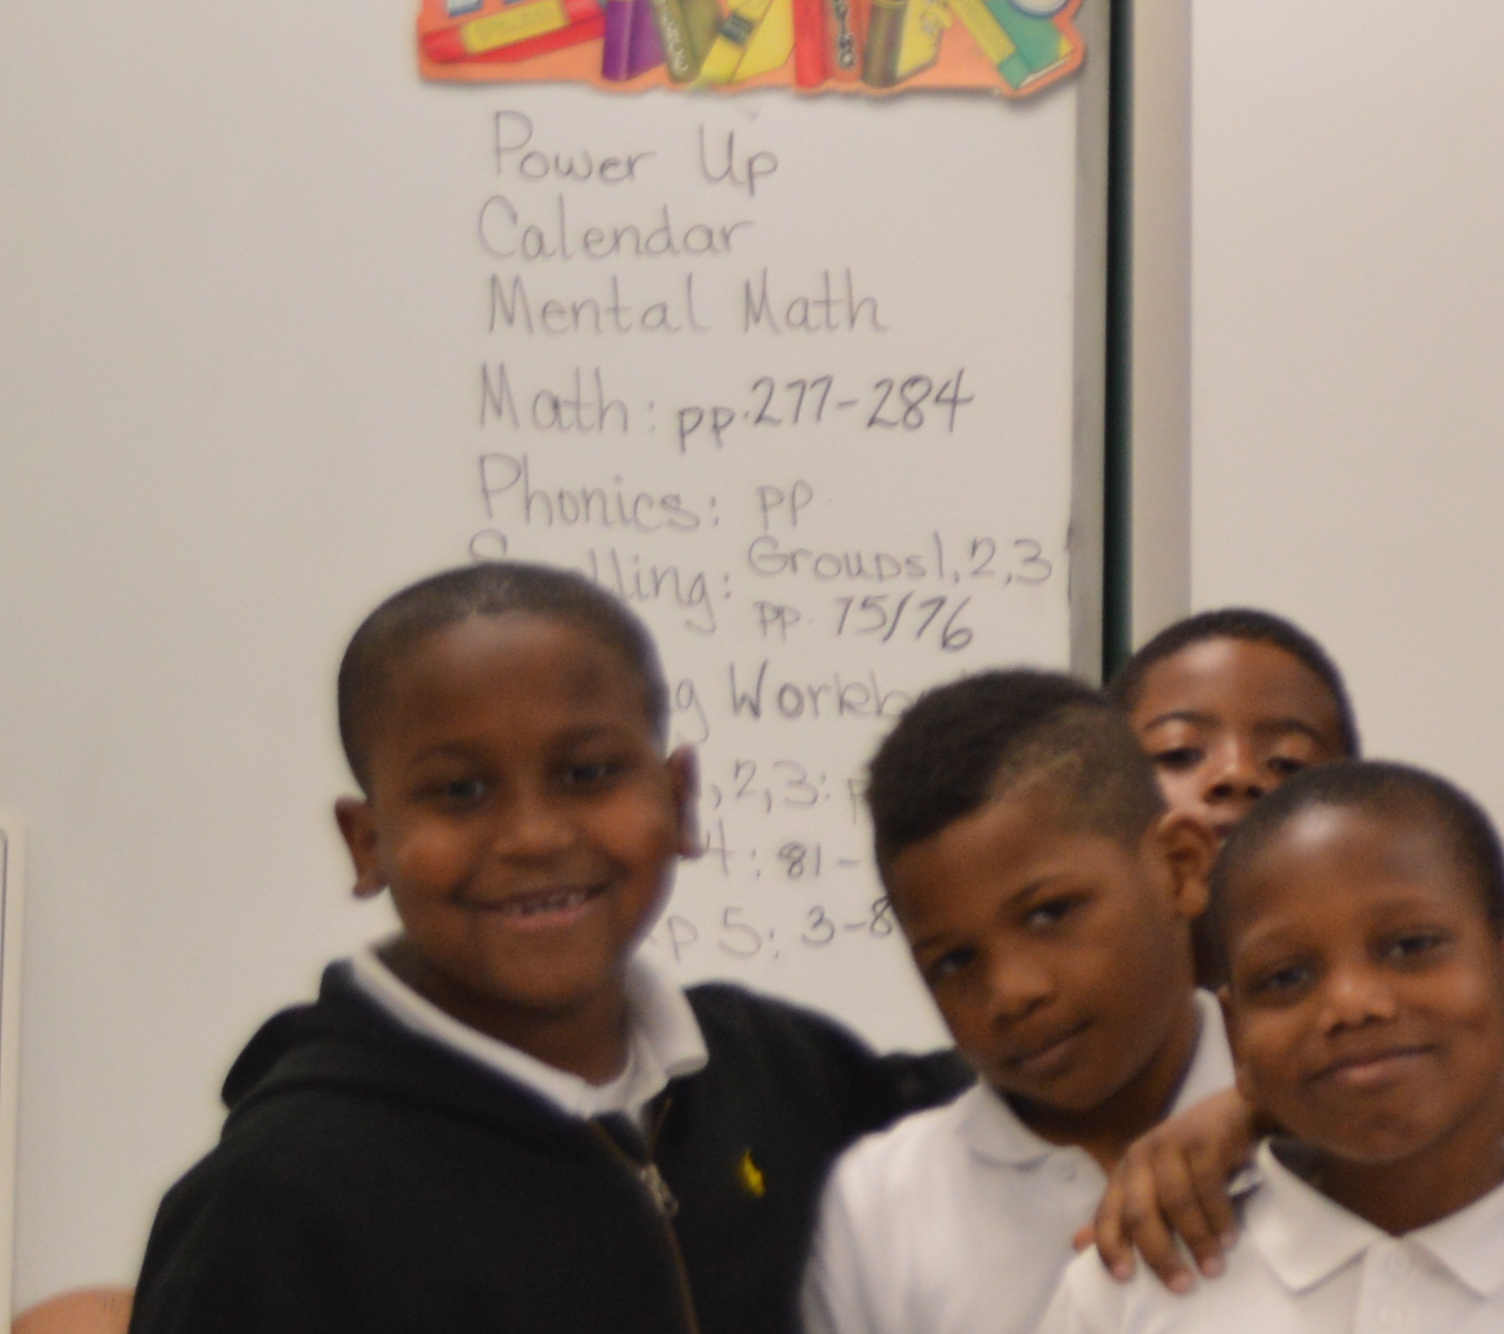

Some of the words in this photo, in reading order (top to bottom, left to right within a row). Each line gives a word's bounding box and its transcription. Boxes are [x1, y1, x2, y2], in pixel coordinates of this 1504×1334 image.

[491, 110, 655, 185] Power
[699, 125, 778, 198] Up
[476, 193, 752, 263] Calendar
[487, 272, 704, 335] Mental
[743, 267, 888, 334] Math
[476, 452, 719, 533] Phonics:
